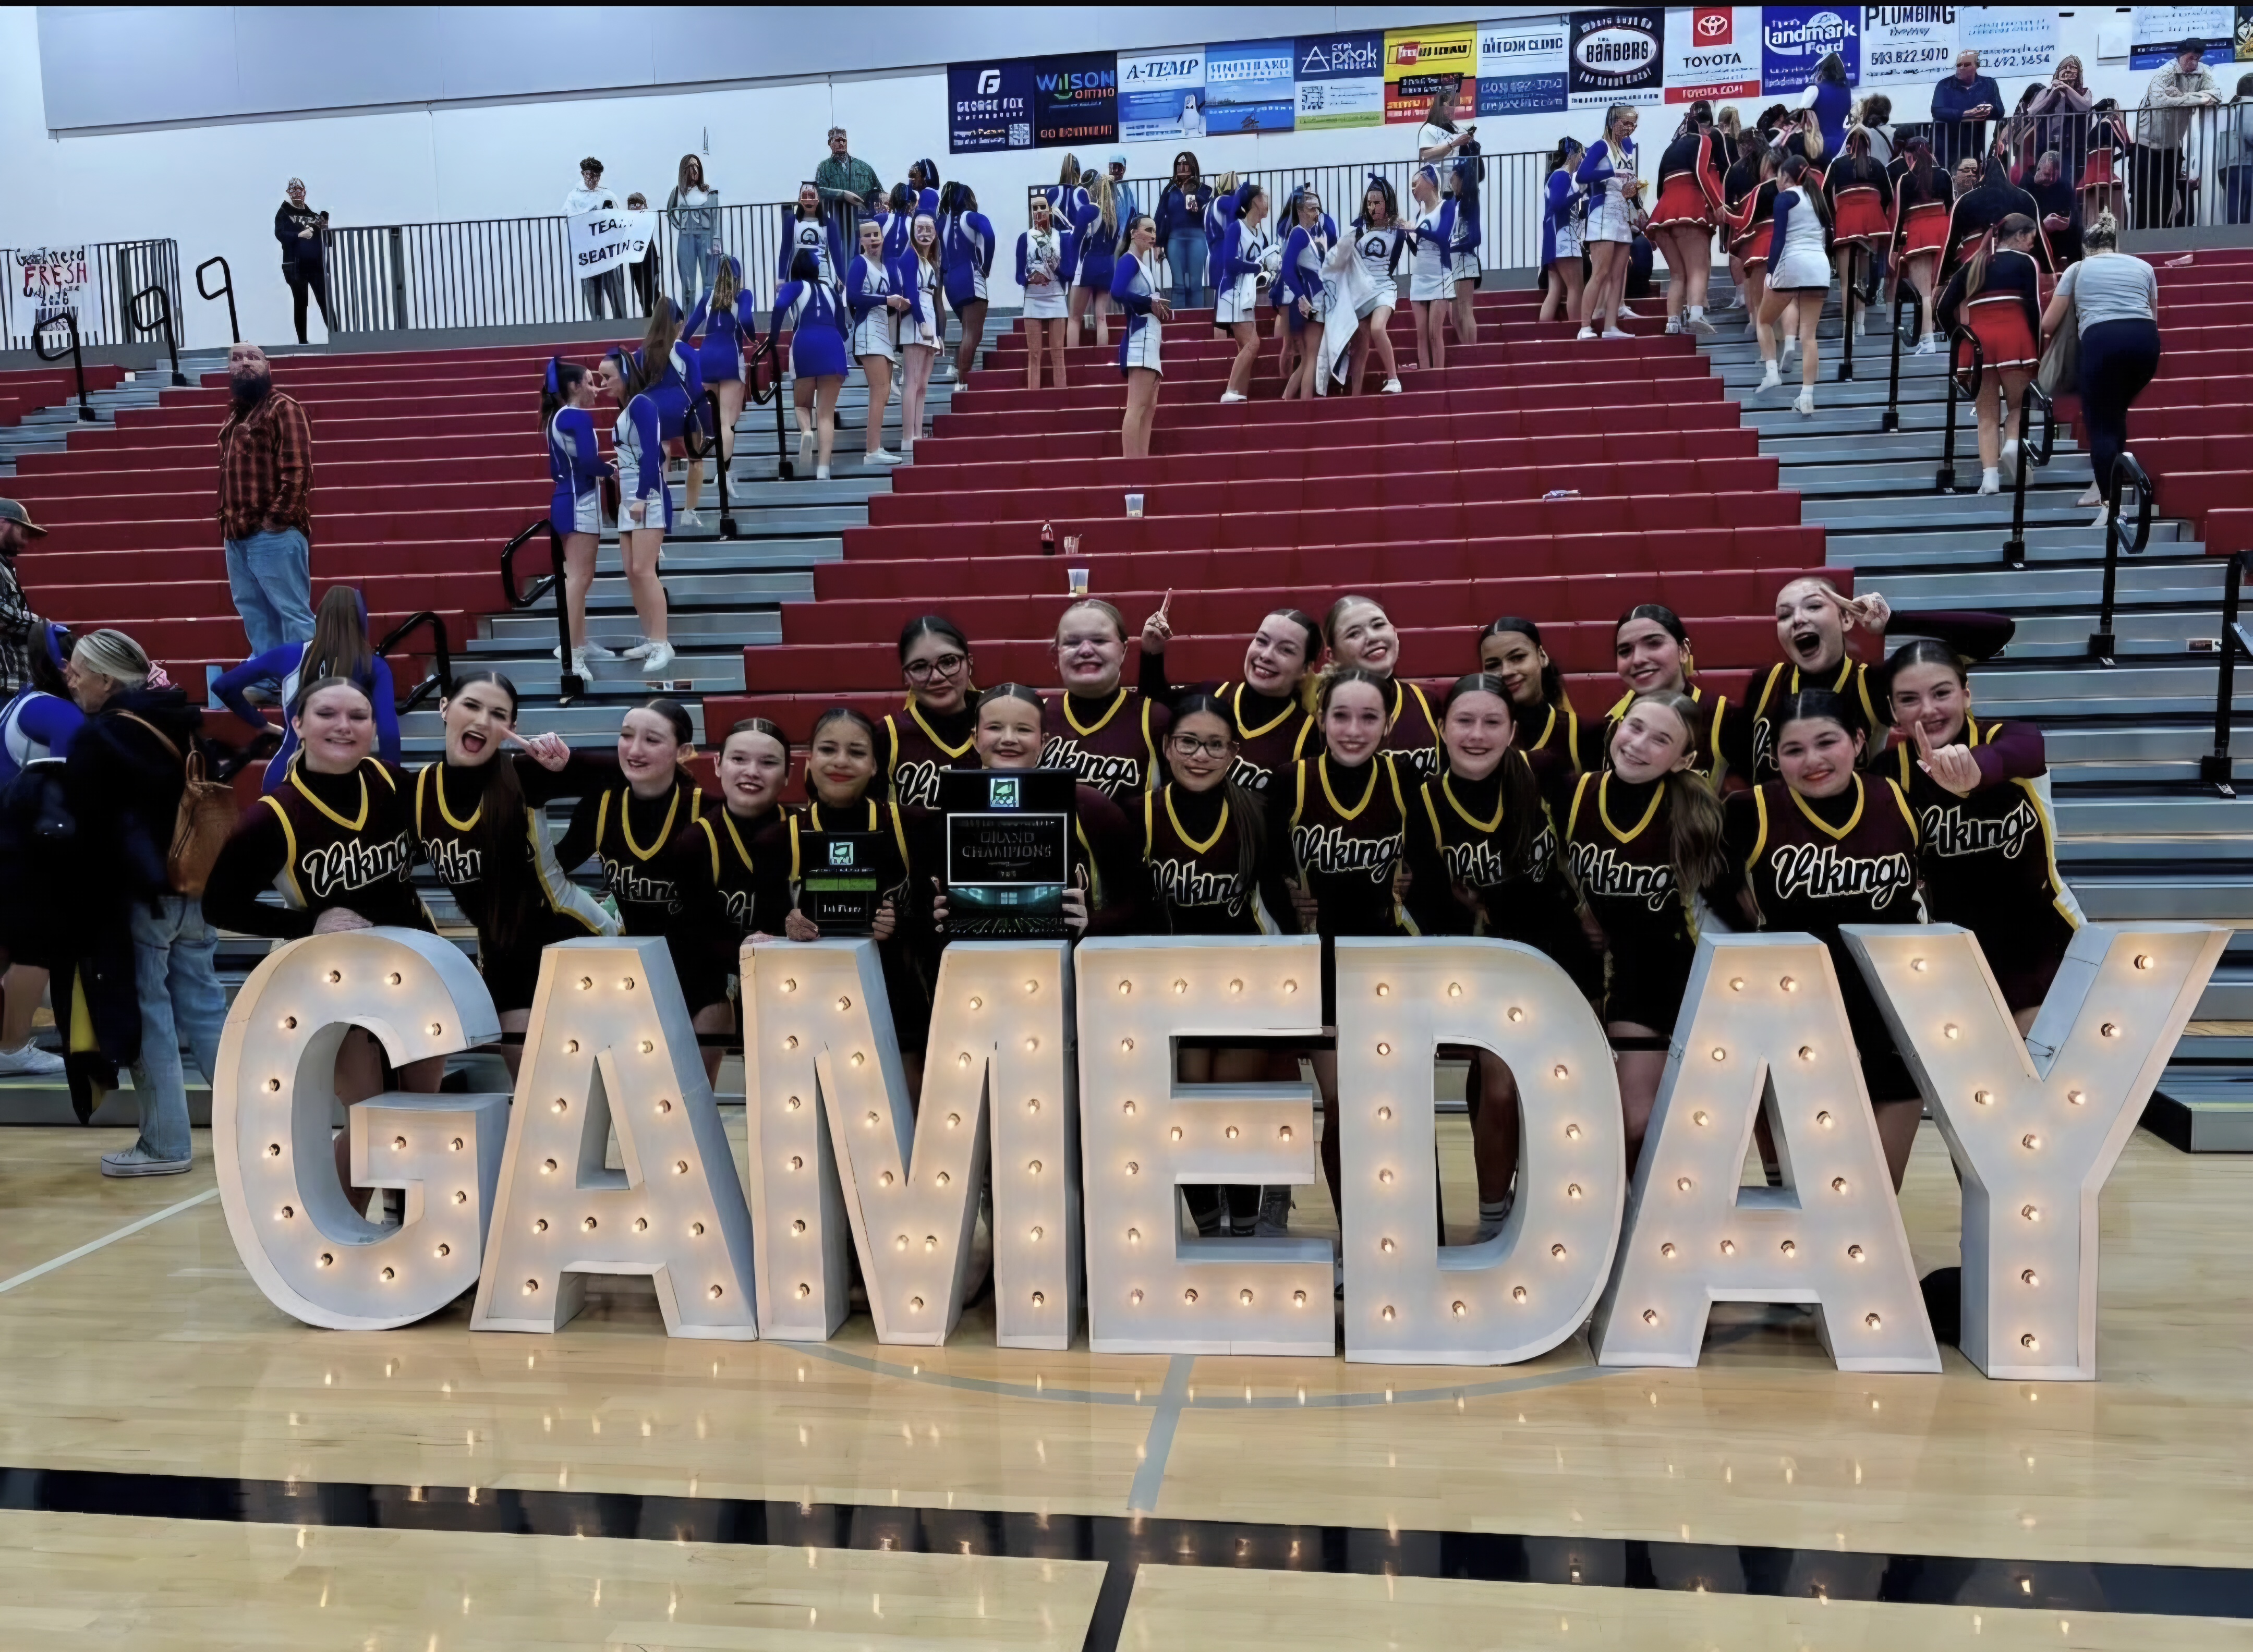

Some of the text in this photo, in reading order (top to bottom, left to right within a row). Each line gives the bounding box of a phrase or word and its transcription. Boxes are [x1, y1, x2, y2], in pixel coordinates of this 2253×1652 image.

[1864, 6, 1955, 31] PLUMBING
[1765, 20, 1857, 55] Landmark
[1806, 39, 1844, 54] Ford
[1126, 59, 1198, 79] A-TEMP
[1682, 52, 1741, 68] TOYOTA
[578, 239, 645, 265] SEATING
[25, 262, 87, 287] FRESH
[302, 829, 416, 897] Viking
[1568, 841, 1679, 912] Viking
[1772, 843, 1911, 909] Vikings
